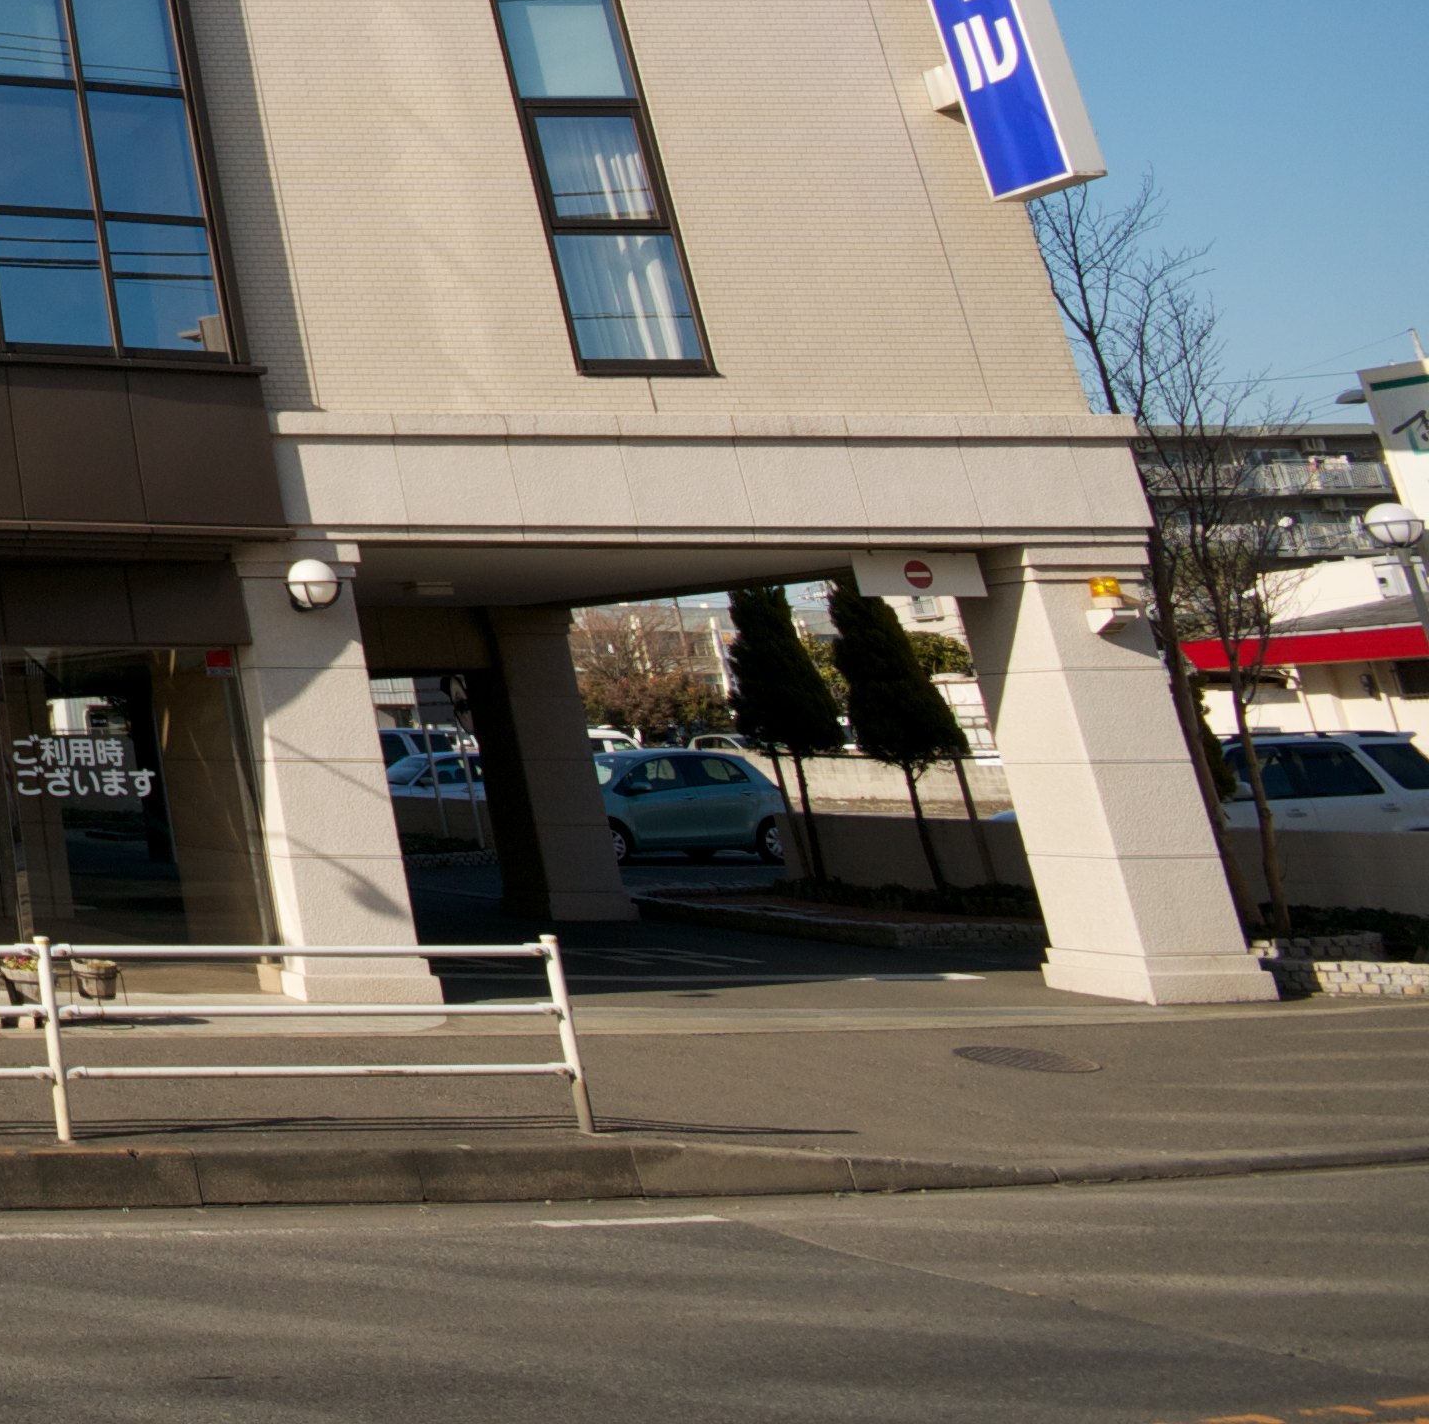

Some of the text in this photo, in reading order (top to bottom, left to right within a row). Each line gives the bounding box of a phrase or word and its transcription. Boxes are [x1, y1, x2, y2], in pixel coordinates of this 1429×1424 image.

[11, 733, 125, 767] ご利用時
[16, 766, 156, 798] ございます
